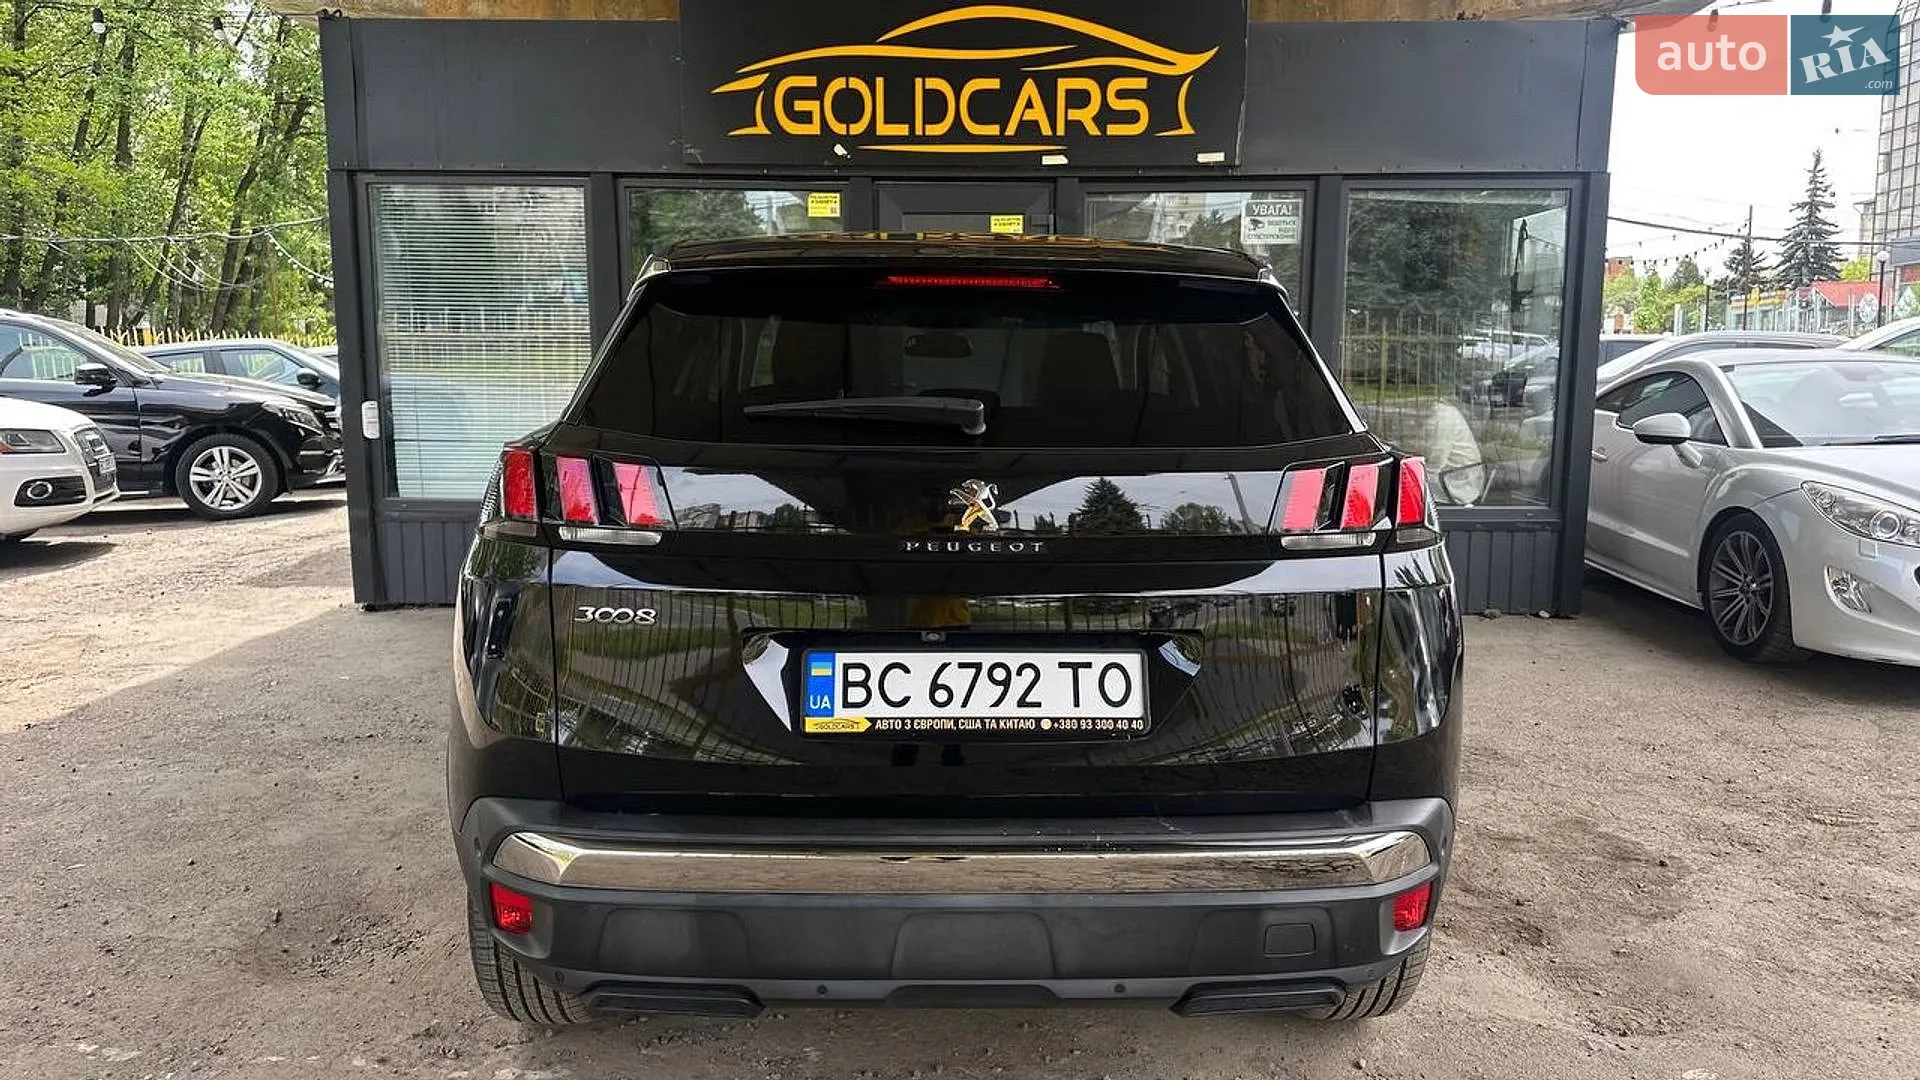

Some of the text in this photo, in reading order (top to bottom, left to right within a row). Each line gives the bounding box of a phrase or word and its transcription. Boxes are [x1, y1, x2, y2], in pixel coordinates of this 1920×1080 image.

[774, 76, 1149, 137] GOLDCARS
[1252, 204, 1292, 215] УВАГА!
[904, 541, 1044, 552] PEUGEOT
[574, 606, 657, 625] 3008
[841, 661, 1133, 709] BC 6792 TO
[809, 694, 832, 710] UA
[875, 719, 902, 730] АВТО
[913, 719, 957, 731] ЄВРОПИ,
[958, 719, 982, 730] США
[984, 719, 997, 730] ТА
[999, 719, 1036, 730] КИТАЮ
[1053, 719, 1144, 730] +380 93 300 40 40
